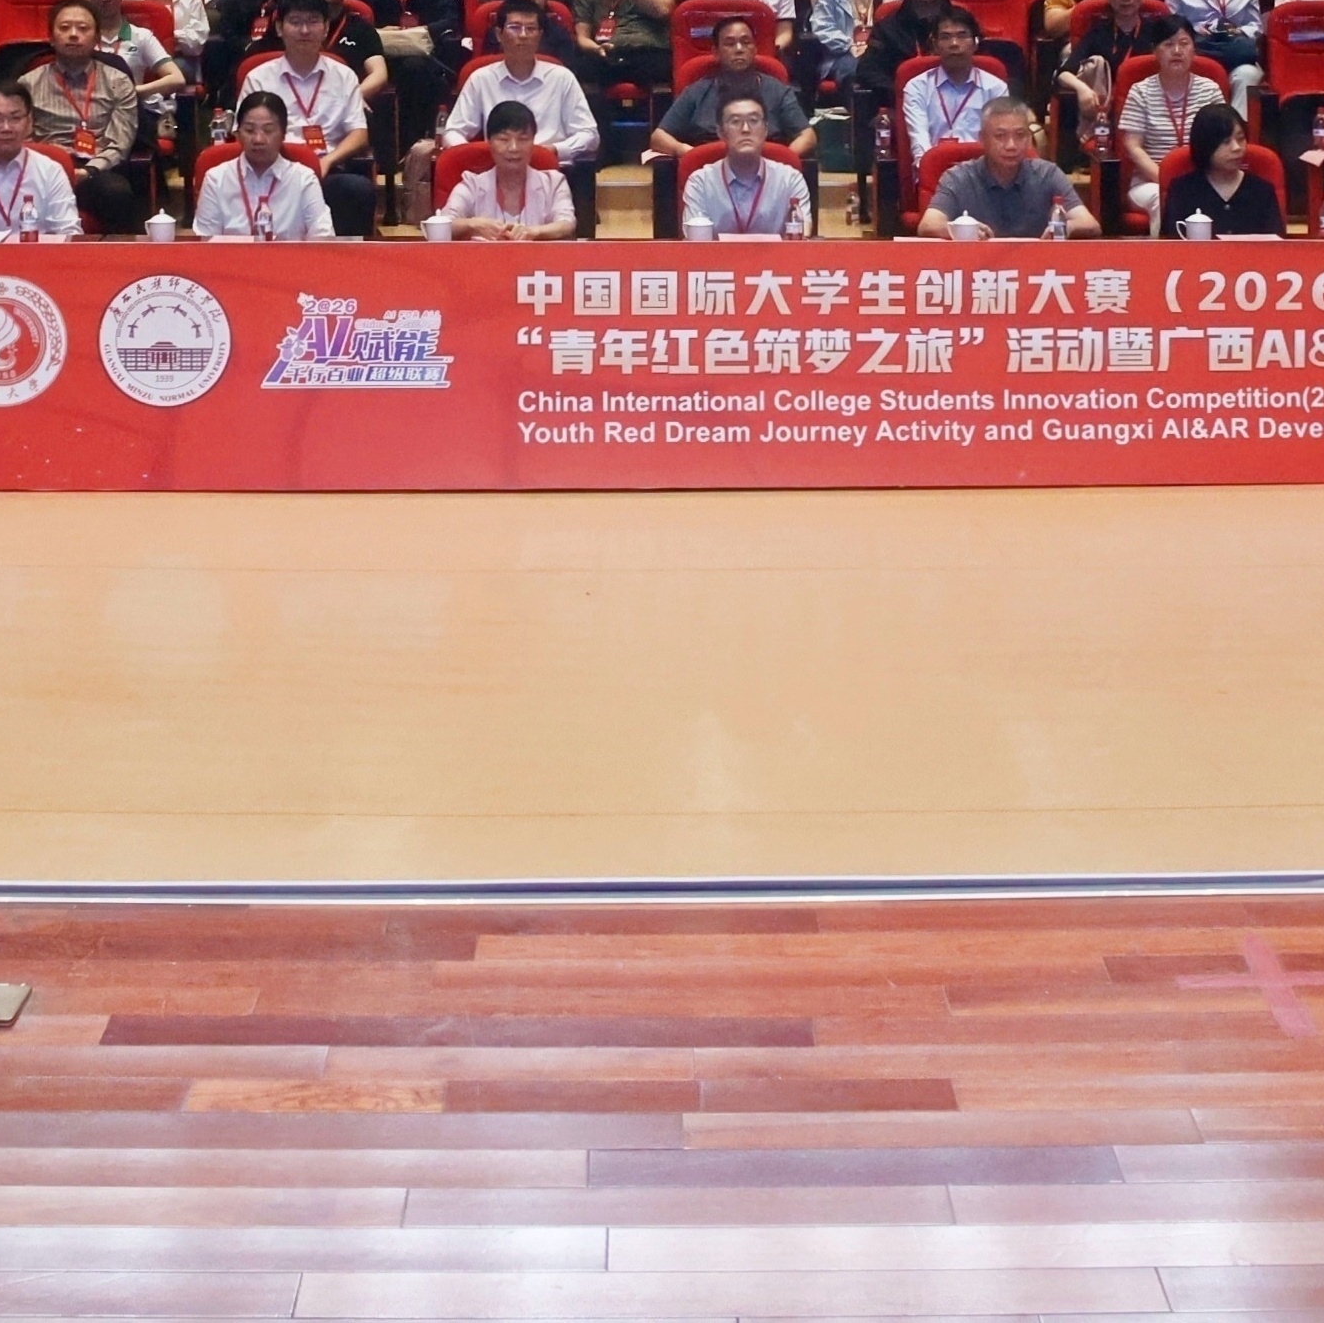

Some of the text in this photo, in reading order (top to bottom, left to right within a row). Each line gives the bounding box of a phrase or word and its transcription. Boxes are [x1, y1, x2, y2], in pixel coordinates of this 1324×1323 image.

[518, 391, 593, 413] China
[602, 390, 765, 412] International
[774, 389, 872, 416] College
[880, 389, 995, 411] Students
[1003, 388, 1138, 410] Innovation
[517, 421, 594, 444] Youth
[604, 421, 656, 443] Red
[665, 421, 751, 443] Dream
[759, 421, 868, 447] Journey
[875, 419, 976, 447] Activity
[984, 419, 1033, 441] and
[1042, 418, 1153, 445] Guangxi
[1162, 417, 1249, 439] AI&AR
